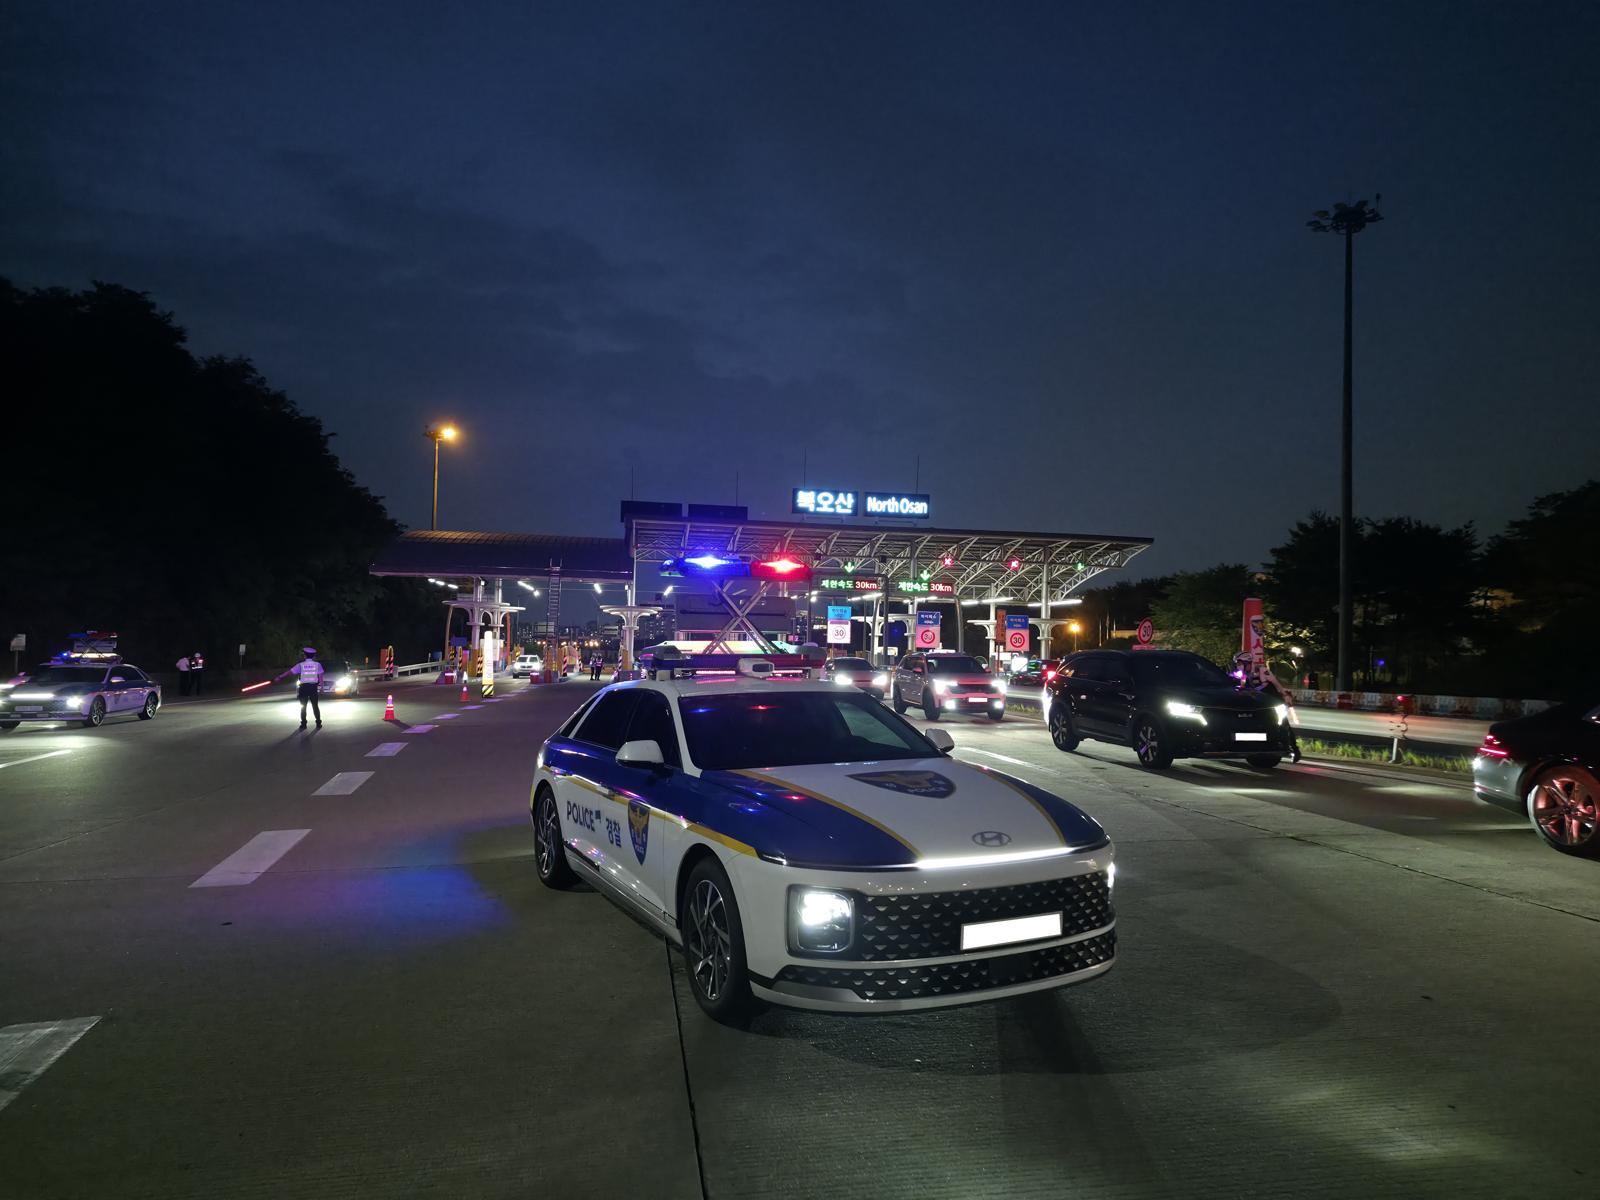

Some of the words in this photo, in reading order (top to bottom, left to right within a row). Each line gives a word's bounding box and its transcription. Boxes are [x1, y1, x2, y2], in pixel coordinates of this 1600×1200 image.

[797, 490, 854, 514] 북오산
[867, 496, 899, 513] North
[900, 497, 928, 514] Osan
[855, 581, 877, 590] 30km
[930, 583, 952, 592] 30km
[834, 629, 845, 637] 30
[1013, 636, 1022, 644] 30
[566, 800, 595, 832] POLICE
[605, 816, 622, 849] 경찰
